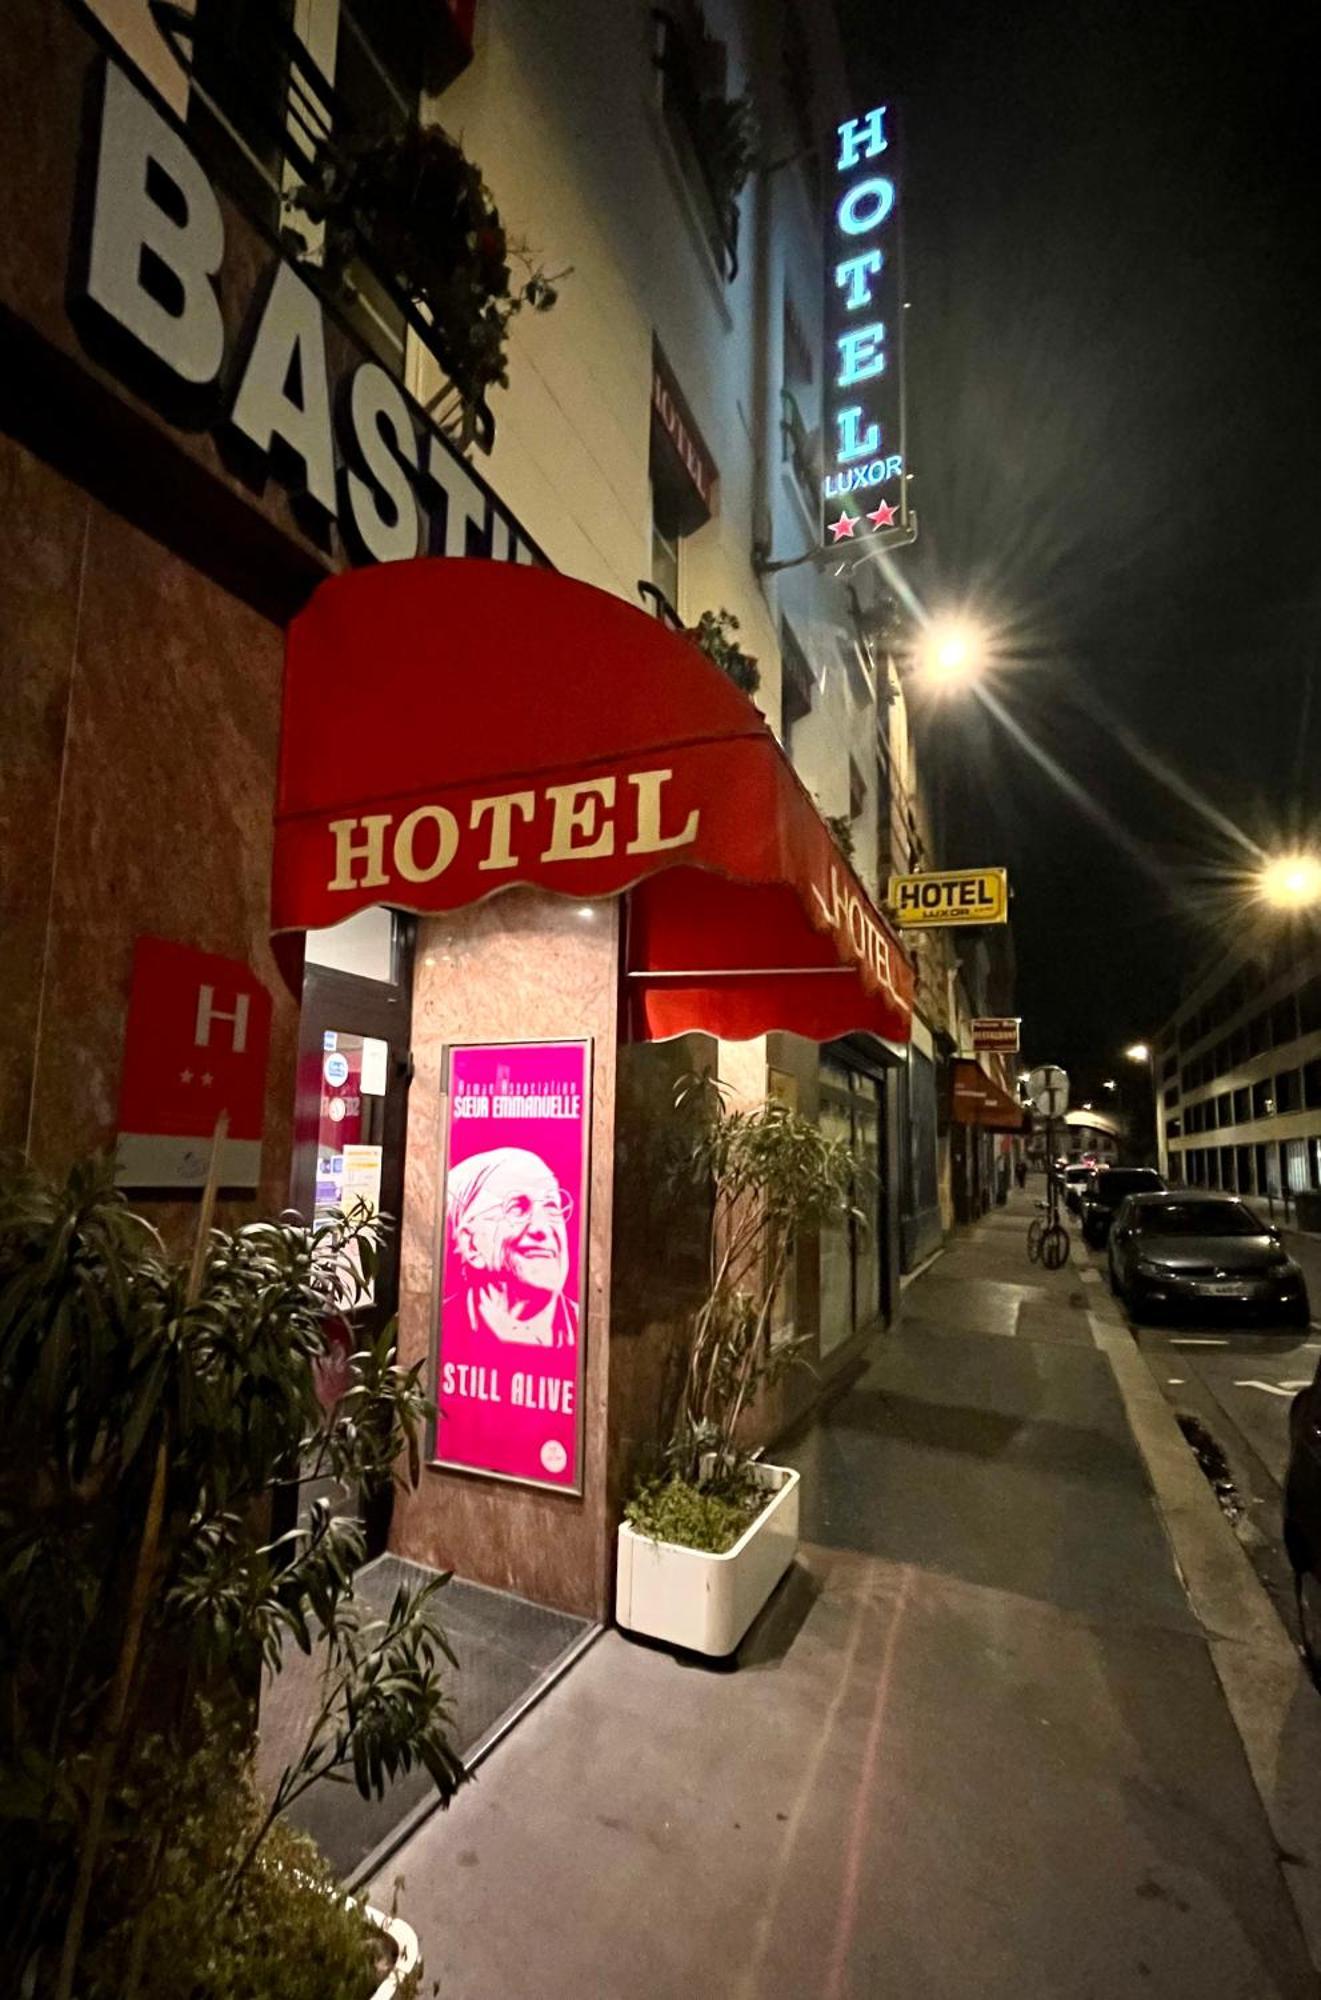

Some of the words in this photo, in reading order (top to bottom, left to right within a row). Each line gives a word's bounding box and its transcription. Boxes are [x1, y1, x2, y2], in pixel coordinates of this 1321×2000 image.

[837, 106, 896, 463] HOTEL
[825, 455, 903, 498] LUXOR
[326, 768, 700, 891] HOTEL
[900, 880, 993, 909] HOTEL
[923, 908, 970, 918] LUXOR
[194, 984, 250, 1053] H
[492, 1094, 580, 1119] EMMANUELLE
[442, 1362, 501, 1402] STILL
[510, 1372, 574, 1415] ALIVE
